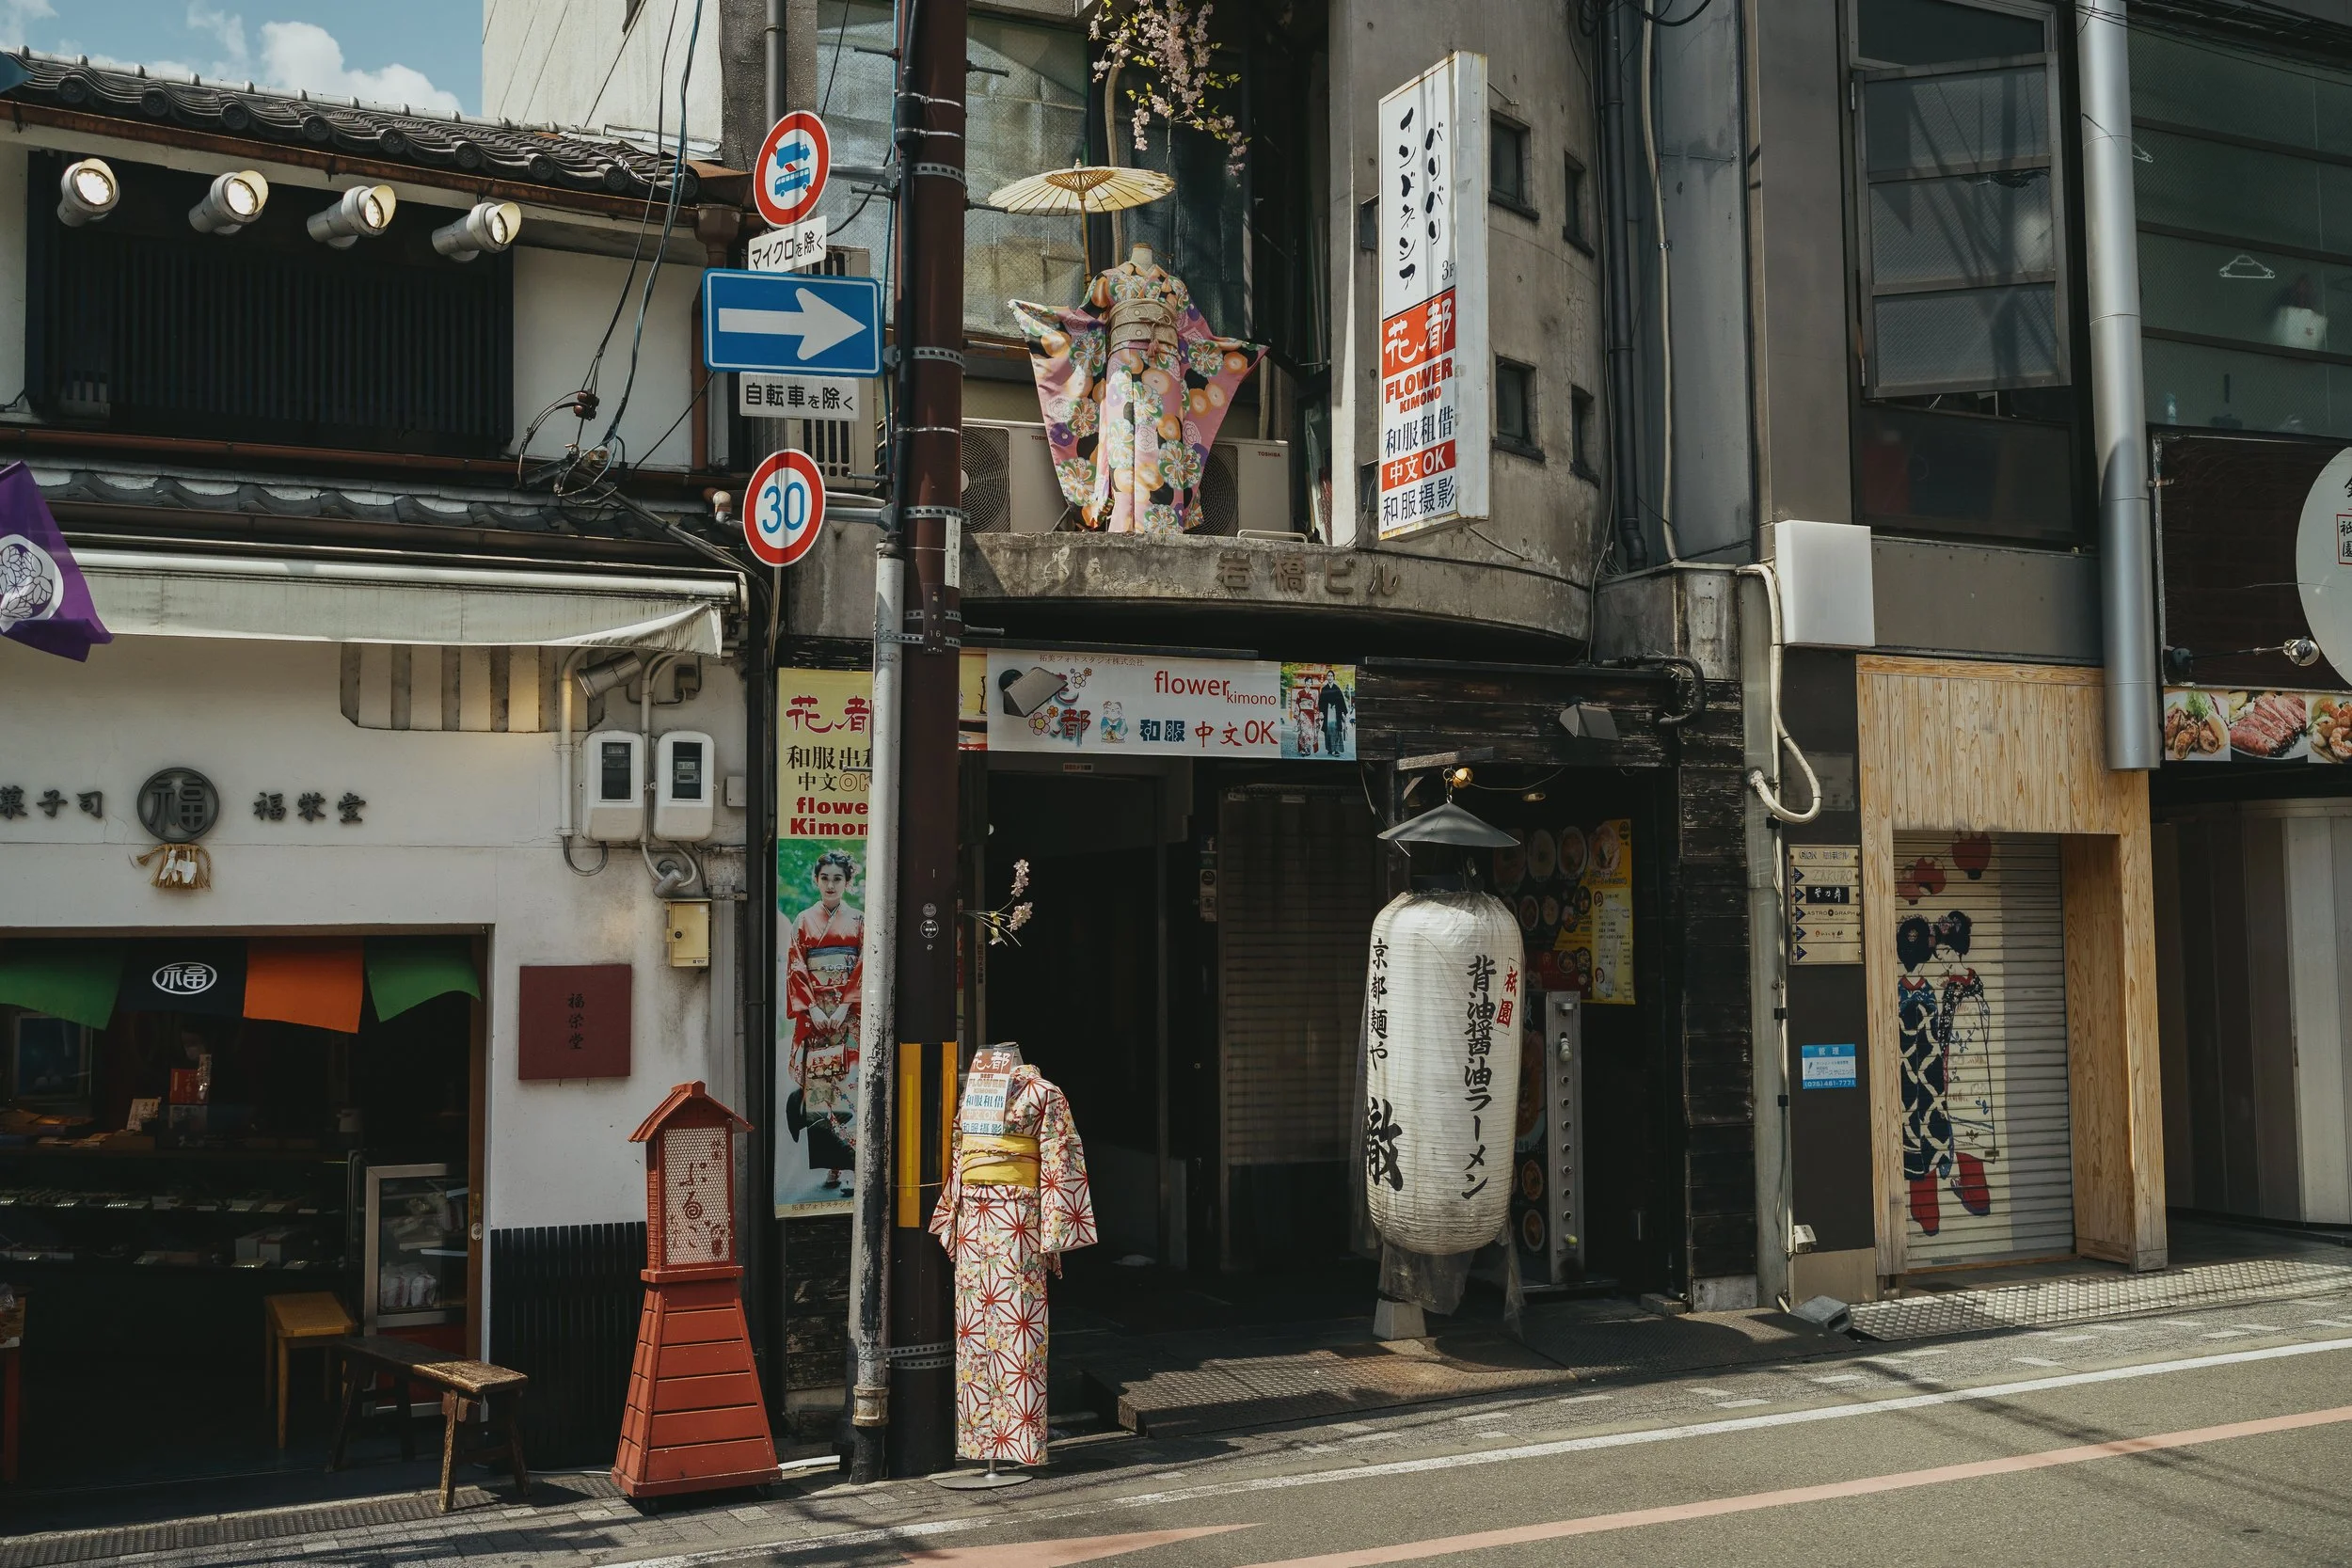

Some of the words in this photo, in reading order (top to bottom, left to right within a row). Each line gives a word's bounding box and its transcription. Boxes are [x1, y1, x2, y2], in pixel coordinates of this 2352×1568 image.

[1399, 107, 1416, 291] インドネシア
[1425, 121, 1443, 245] バリバリ
[752, 230, 823, 269] マイクロを除く
[1441, 260, 1455, 281] 3F
[1385, 297, 1453, 367] 花都
[745, 382, 853, 411] 自転車を除く
[1385, 356, 1454, 404] FLOWER
[1399, 386, 1442, 414] KIMONO
[1385, 405, 1454, 458] 和服租借
[761, 481, 805, 534] 30
[1383, 475, 1455, 527] 和服摄影
[1216, 550, 1402, 596] 岩橋ビル
[1154, 670, 1231, 696] flower
[1226, 689, 1277, 705] kimono
[1139, 719, 1185, 742] 和服
[0, 784, 103, 820] 菓子司
[148, 777, 208, 833] 福
[252, 790, 368, 825] 福栄堂
[796, 796, 869, 815] flowe
[789, 816, 868, 836] Kimon
[160, 965, 207, 990] 福
[968, 1078, 1007, 1088] FLOWER
[1460, 954, 1498, 1200] 背油醤油ラーメン
[791, 1199, 854, 1212] 拓美フォトスタジオ
